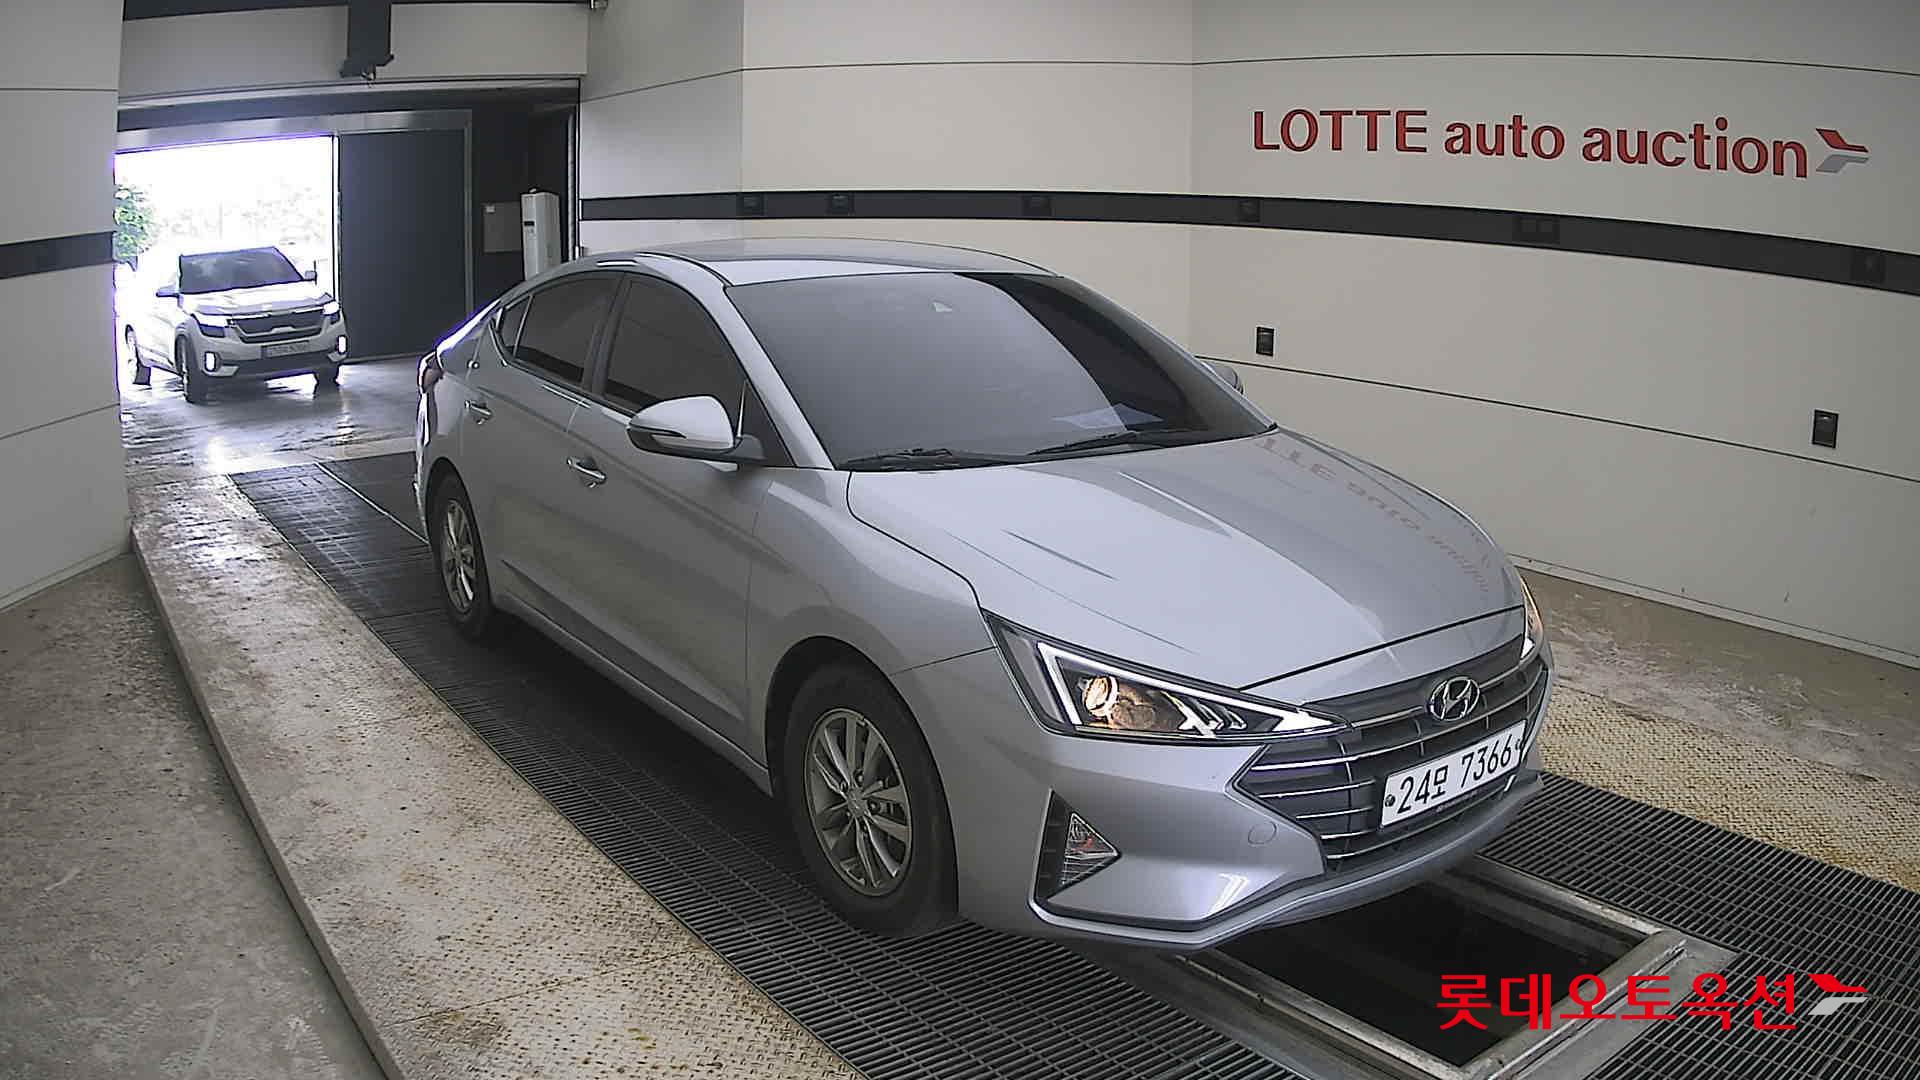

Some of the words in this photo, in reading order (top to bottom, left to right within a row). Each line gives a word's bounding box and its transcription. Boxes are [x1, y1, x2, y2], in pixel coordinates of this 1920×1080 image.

[1254, 110, 1428, 152] LOTTE
[1444, 115, 1566, 160] auto
[1582, 117, 1808, 179] auction
[1397, 764, 1449, 815] 24모
[1460, 733, 1513, 788] 7366
